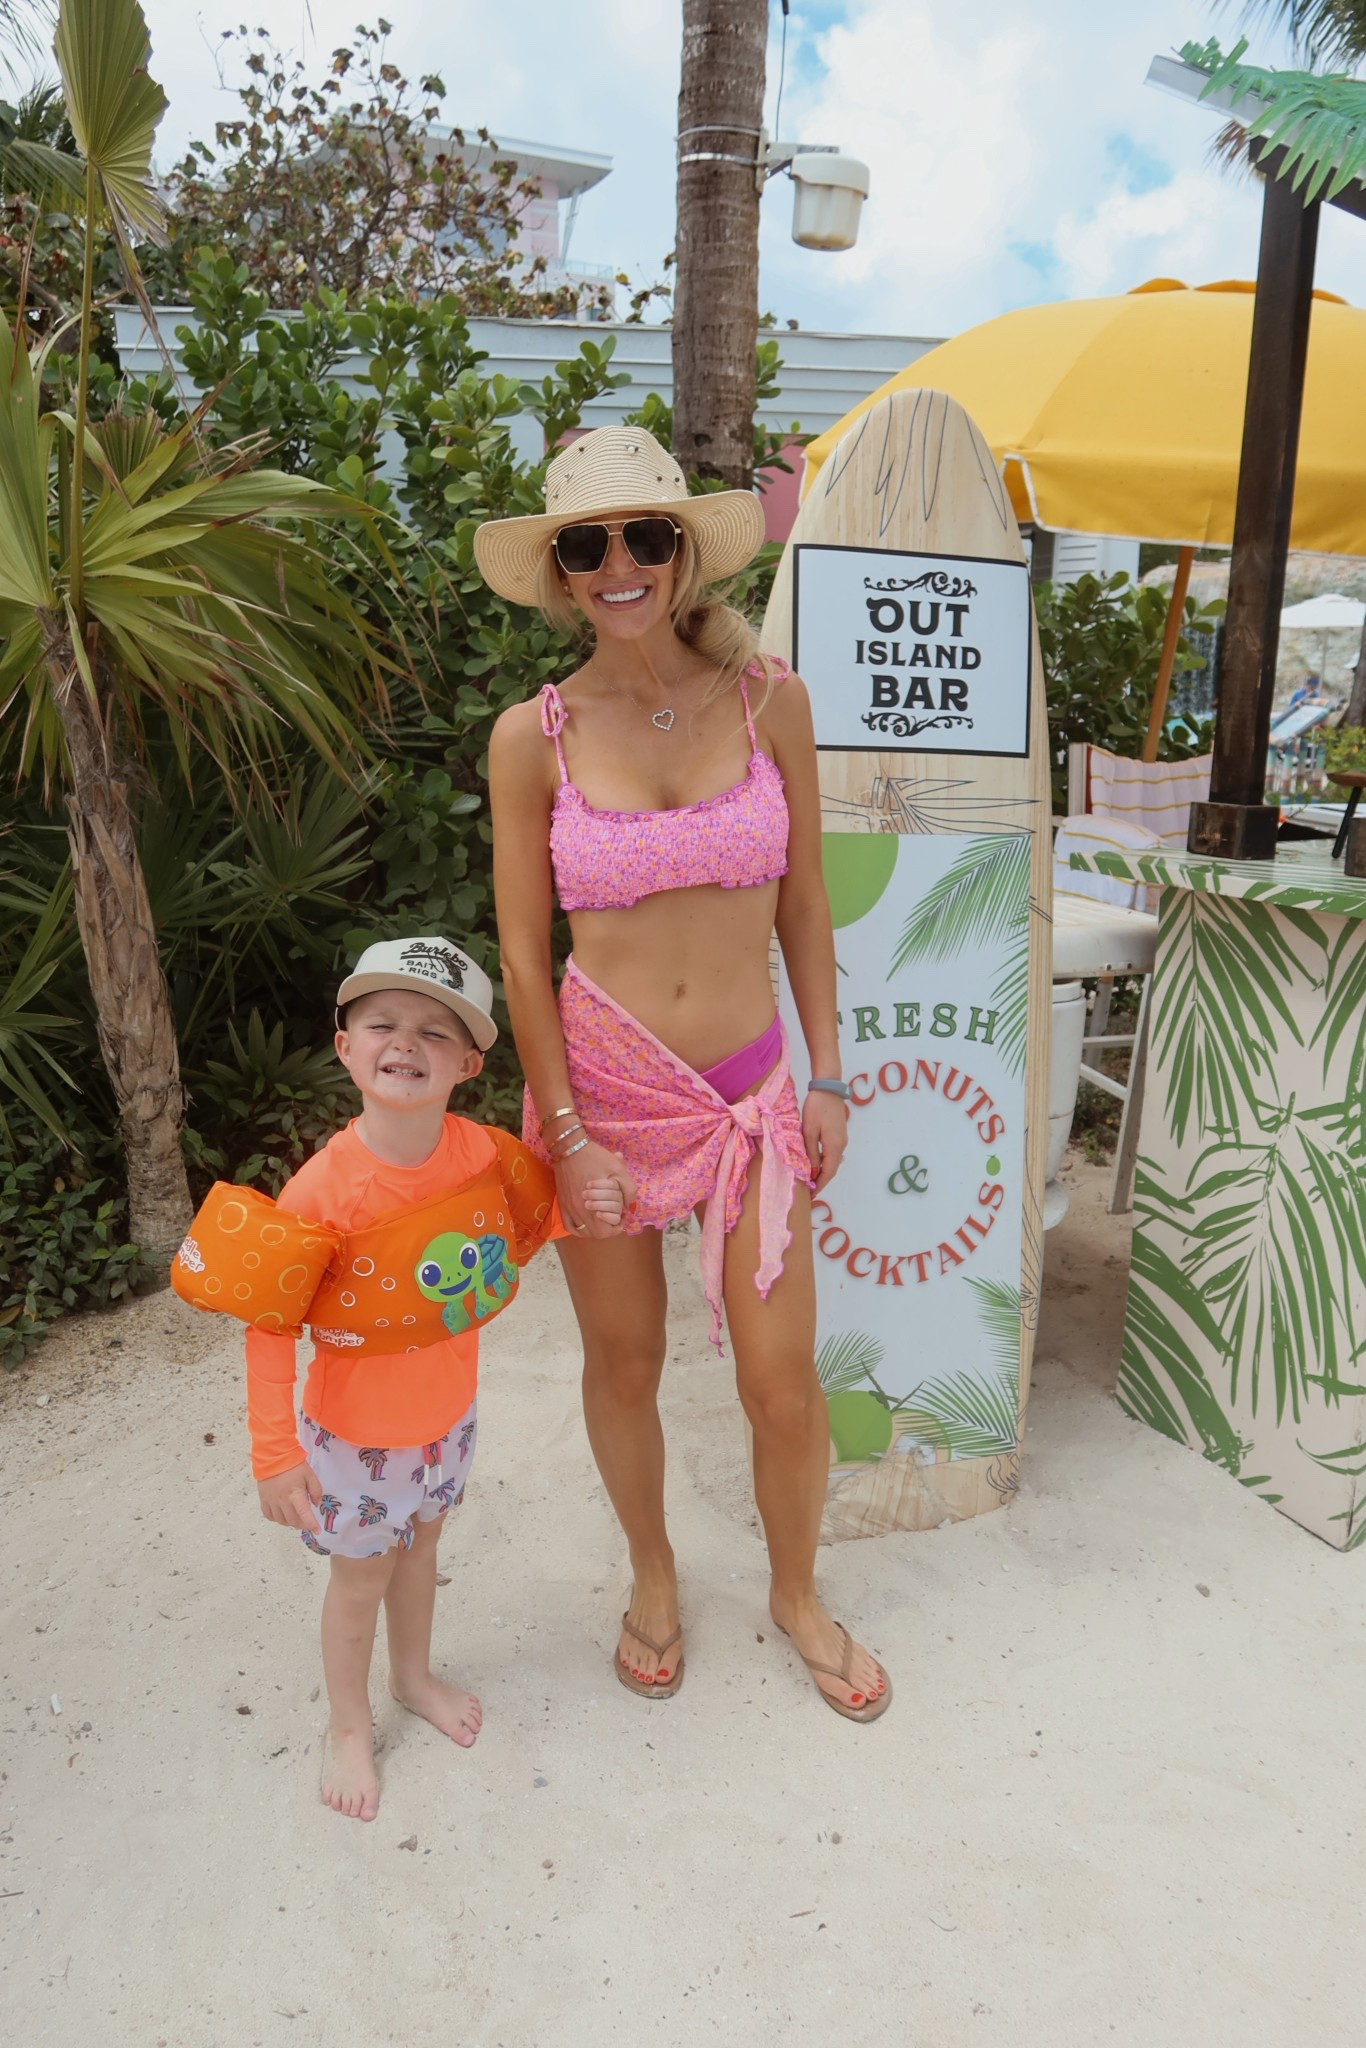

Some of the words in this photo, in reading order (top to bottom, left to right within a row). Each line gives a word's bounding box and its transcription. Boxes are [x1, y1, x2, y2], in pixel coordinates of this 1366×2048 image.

[866, 597, 970, 637] OUT
[855, 640, 981, 670] ISLAND
[870, 674, 968, 712] BAR
[406, 960, 437, 970] BAIT
[408, 967, 437, 979] RIGS
[837, 1003, 1000, 1045] RESH
[845, 1059, 1006, 1145] CONUTS
[887, 1154, 929, 1195] &
